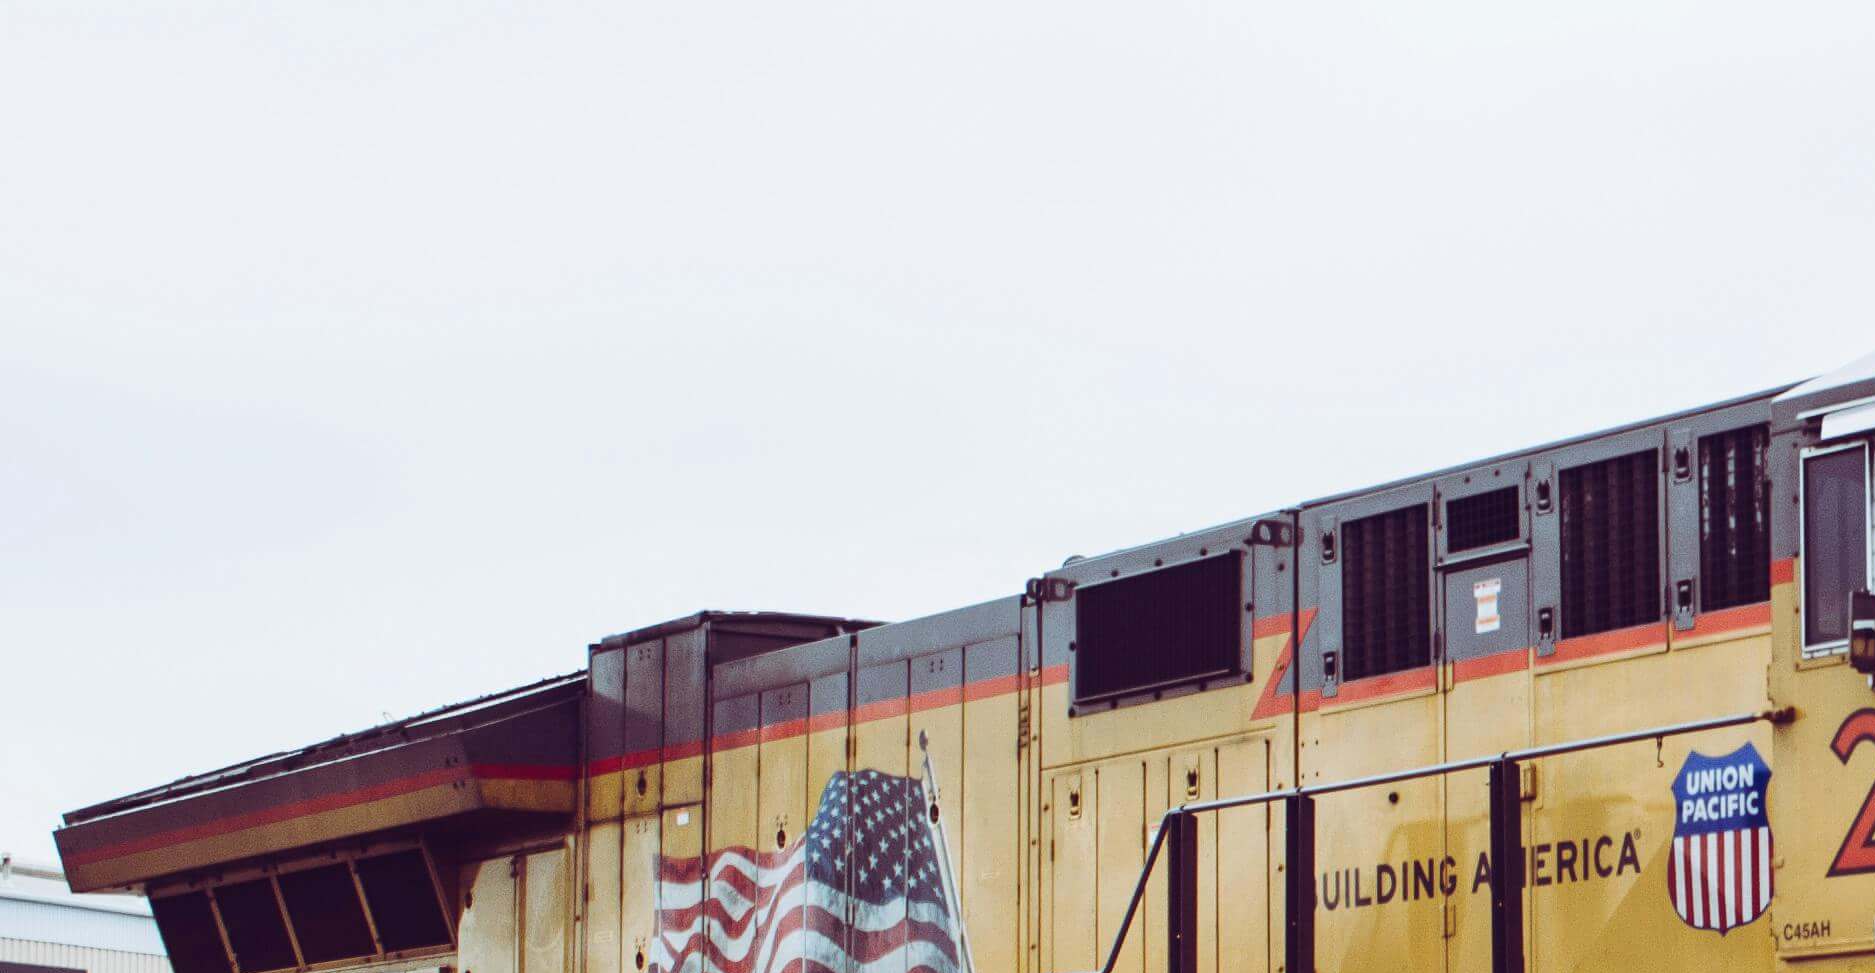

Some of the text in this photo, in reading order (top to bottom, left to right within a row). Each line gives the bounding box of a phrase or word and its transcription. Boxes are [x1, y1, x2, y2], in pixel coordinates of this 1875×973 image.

[1685, 762, 1755, 796] UNION
[1681, 790, 1760, 825] PACIFIC
[1313, 855, 1458, 912] UILDING
[1783, 919, 1832, 941] C45AH
